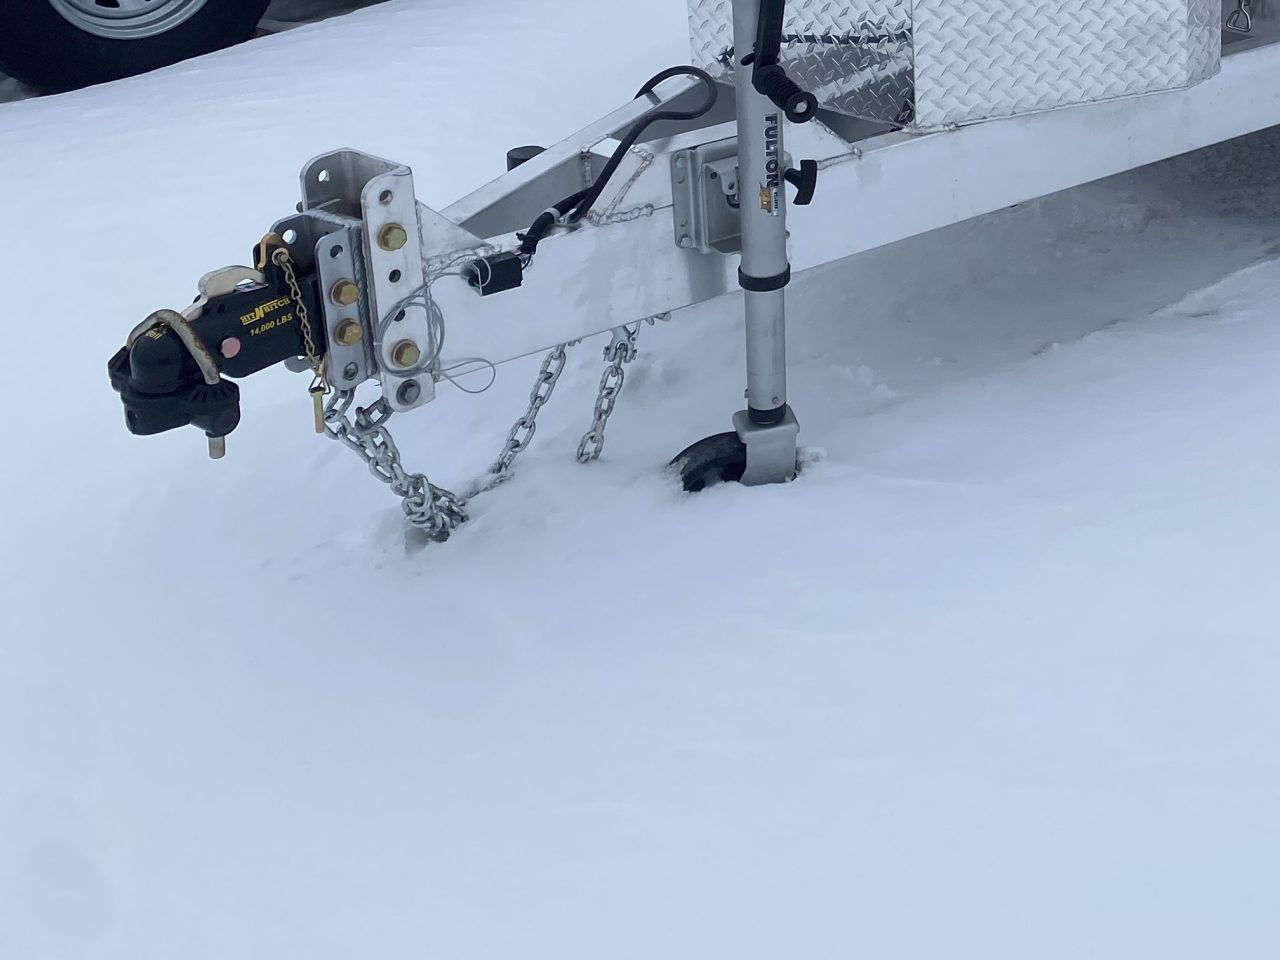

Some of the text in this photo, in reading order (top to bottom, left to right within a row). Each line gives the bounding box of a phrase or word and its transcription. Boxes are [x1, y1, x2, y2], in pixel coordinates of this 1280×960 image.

[764, 113, 779, 187] FULTON
[250, 313, 293, 336] 14,000 LBS
